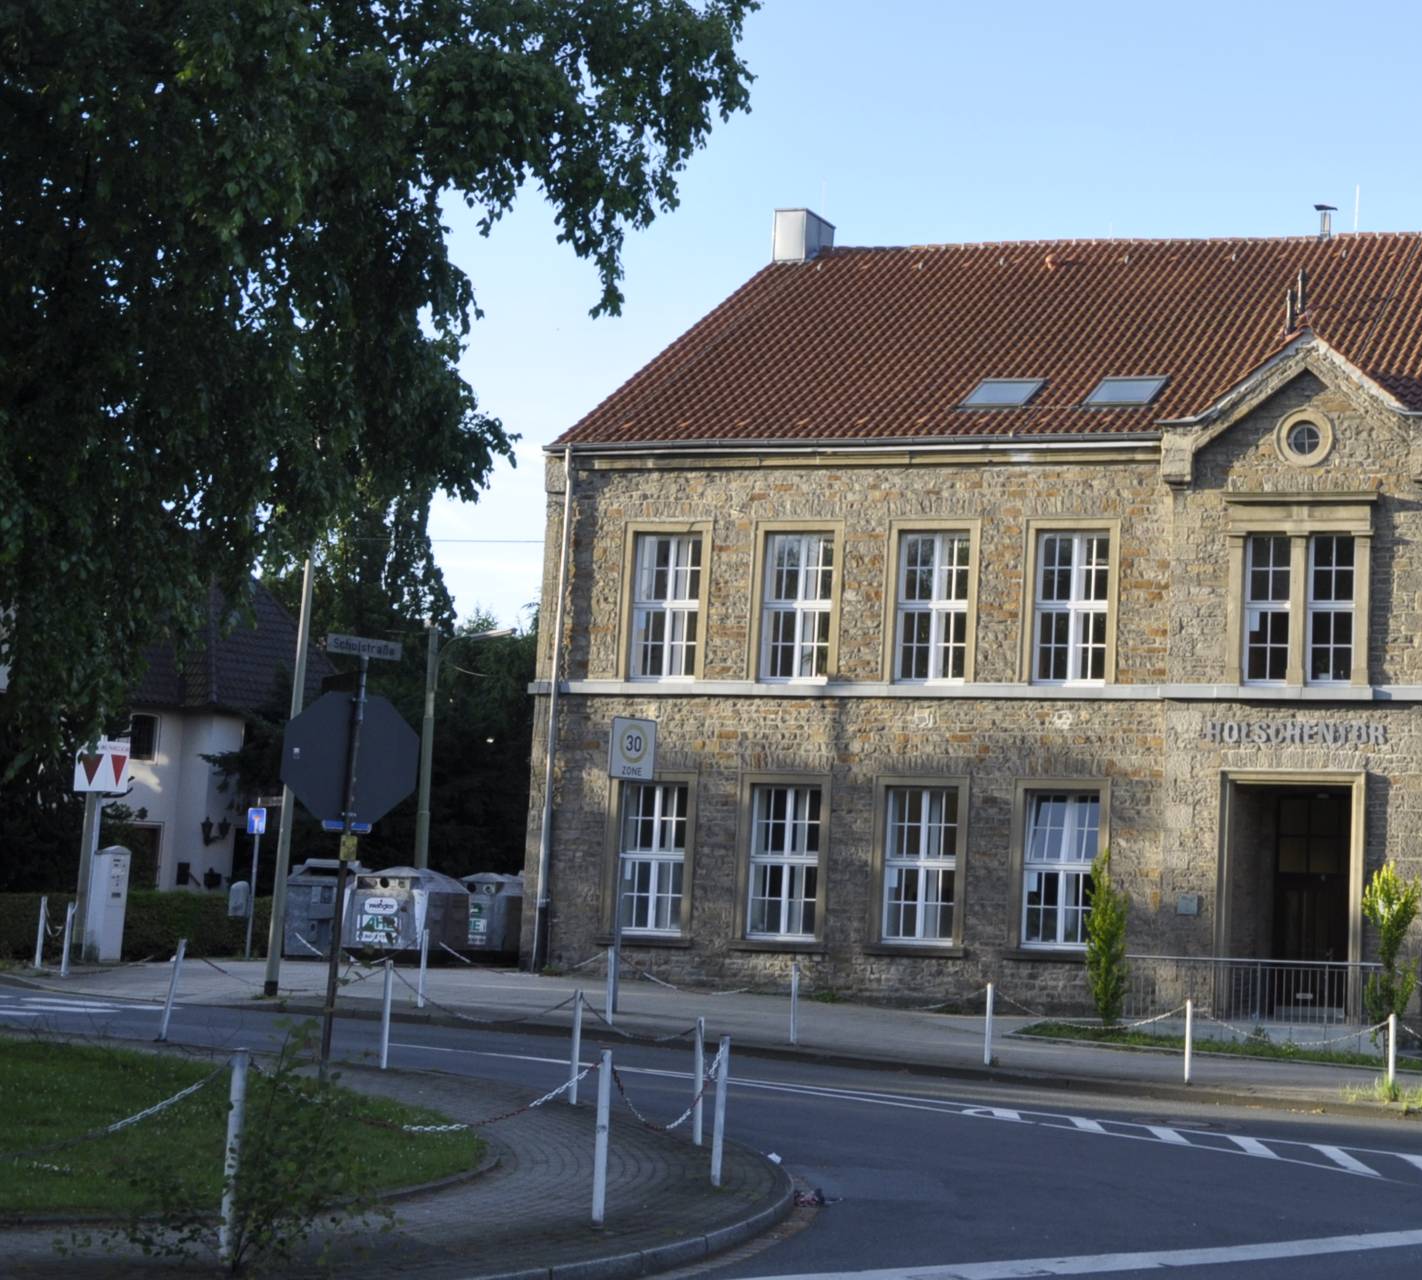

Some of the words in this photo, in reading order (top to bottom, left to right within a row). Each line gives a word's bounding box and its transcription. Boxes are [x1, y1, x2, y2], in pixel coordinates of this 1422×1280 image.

[334, 637, 395, 656] Schulstraße
[1205, 719, 1387, 746] HOLSCHENTOR
[626, 735, 642, 752] 30
[622, 766, 643, 777] ZONE
